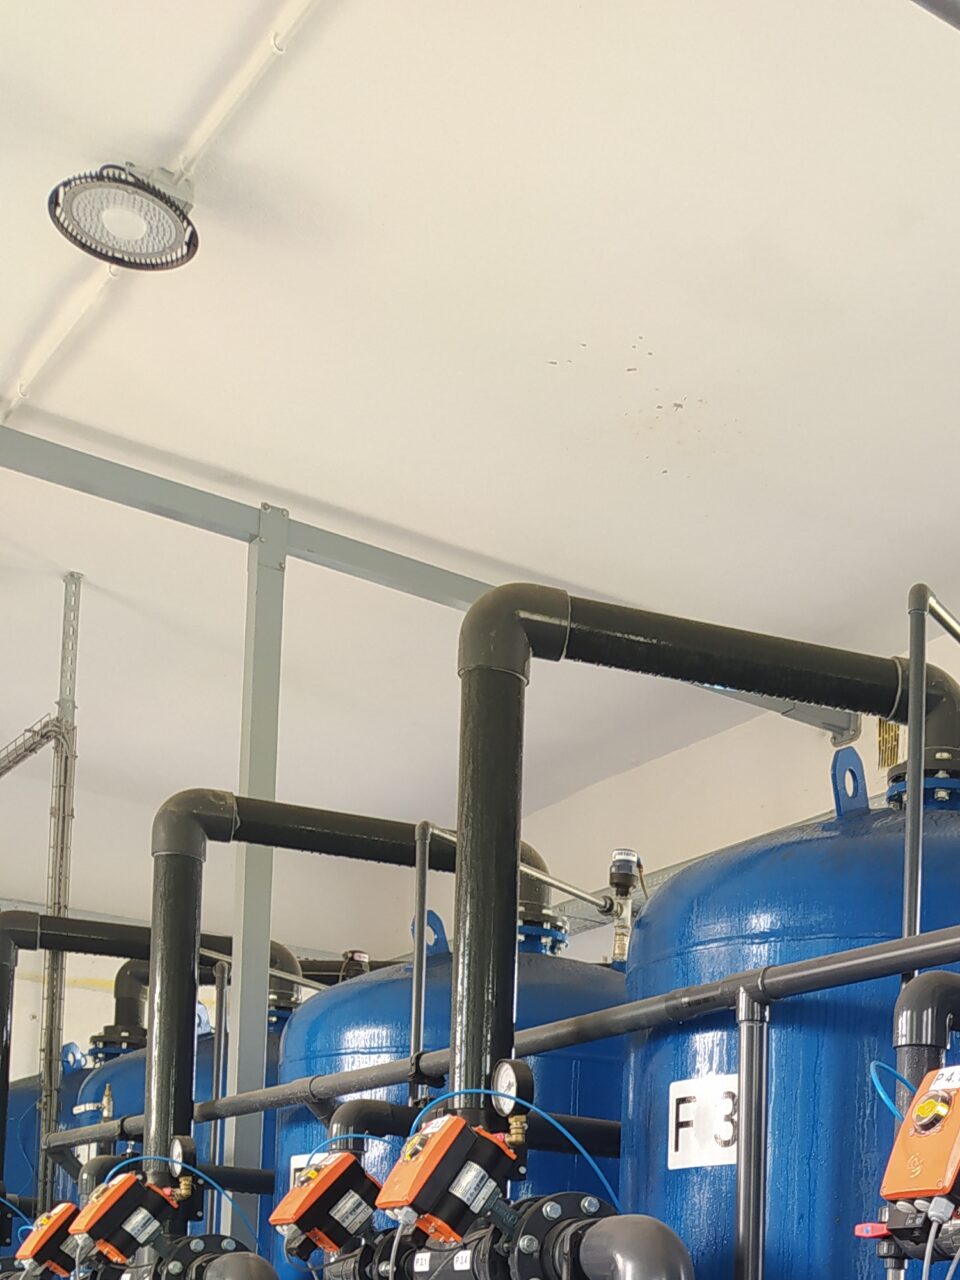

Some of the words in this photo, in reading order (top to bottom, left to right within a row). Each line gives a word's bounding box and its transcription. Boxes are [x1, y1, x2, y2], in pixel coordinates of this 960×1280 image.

[932, 1073, 945, 1086] P
[674, 1095, 697, 1152] F
[714, 1091, 738, 1148] 3
